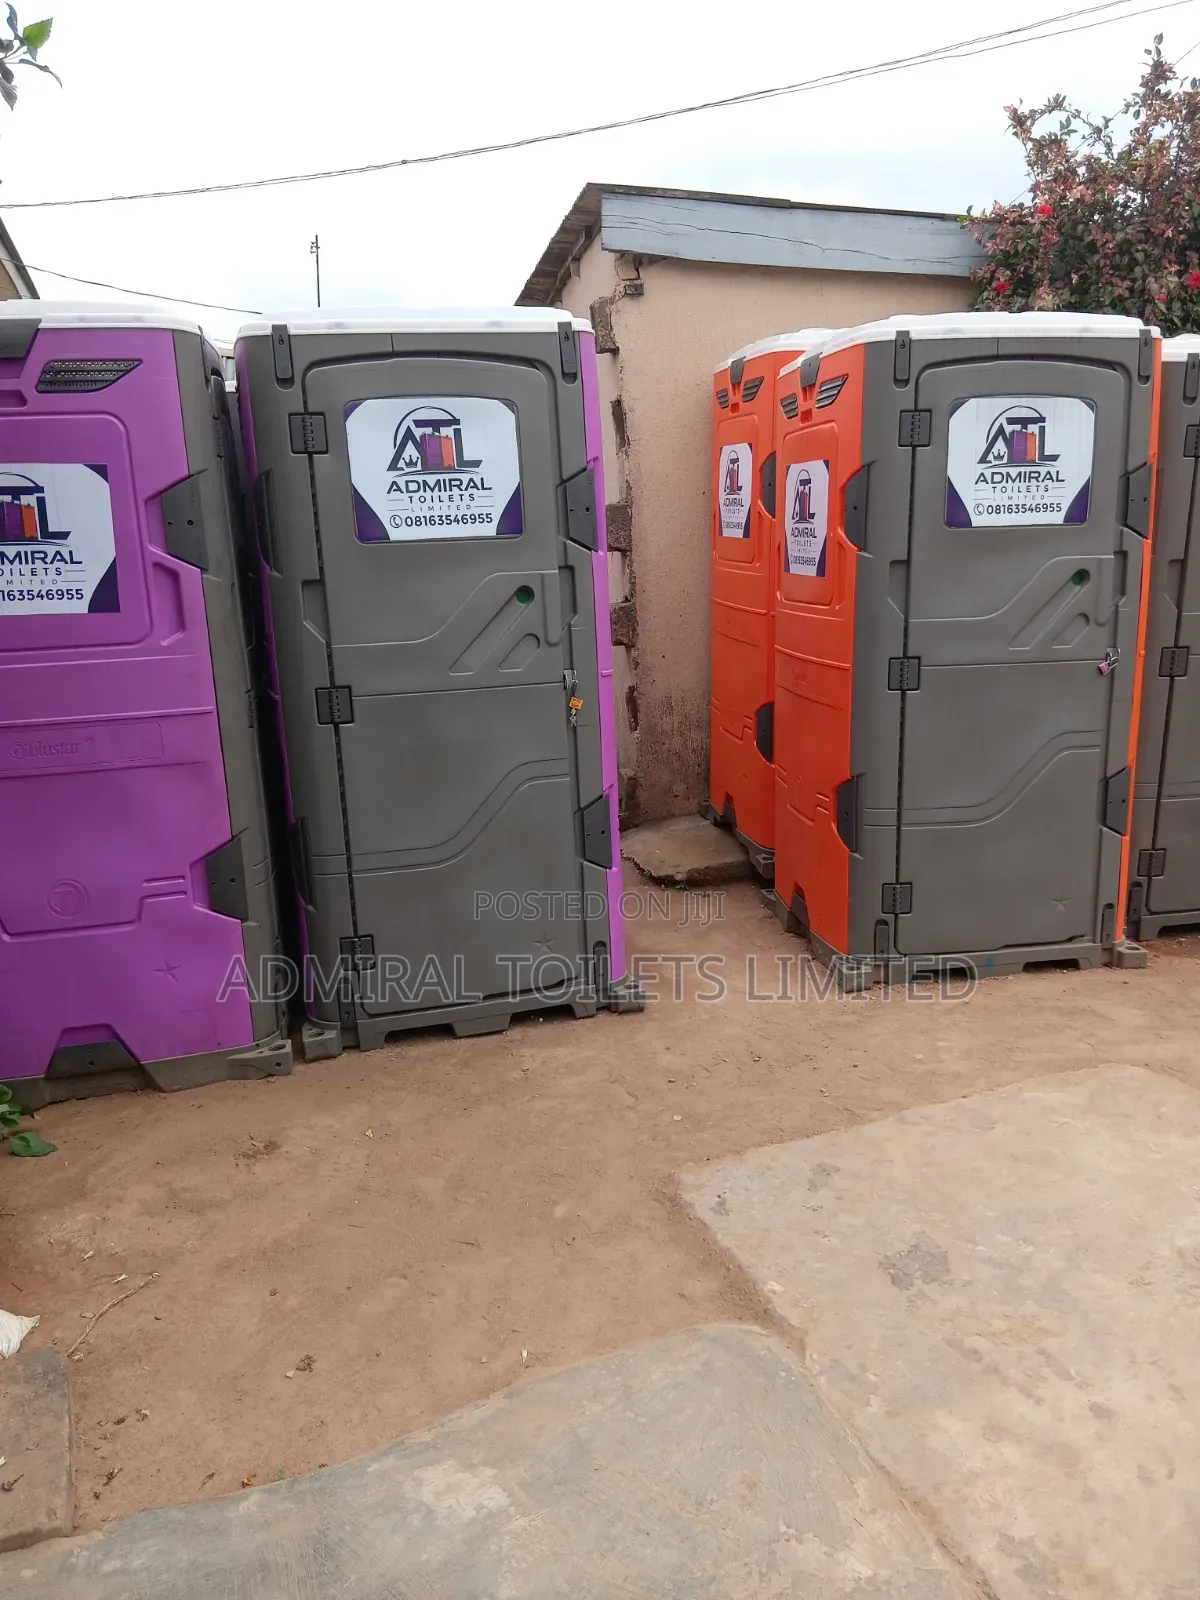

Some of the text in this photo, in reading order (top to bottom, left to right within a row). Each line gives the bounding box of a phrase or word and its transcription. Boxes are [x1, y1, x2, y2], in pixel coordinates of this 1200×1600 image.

[974, 470, 1066, 485] ADMIRAL
[386, 477, 493, 495] ADMIRAL
[991, 485, 1050, 494] TOILETS
[408, 493, 475, 504] TOILETS
[723, 498, 745, 508] ADMIRAL
[411, 504, 472, 513] LIMITED
[986, 502, 1062, 515] 08163546955
[404, 512, 493, 527] 08163546955
[791, 527, 818, 539] ADMIRAL
